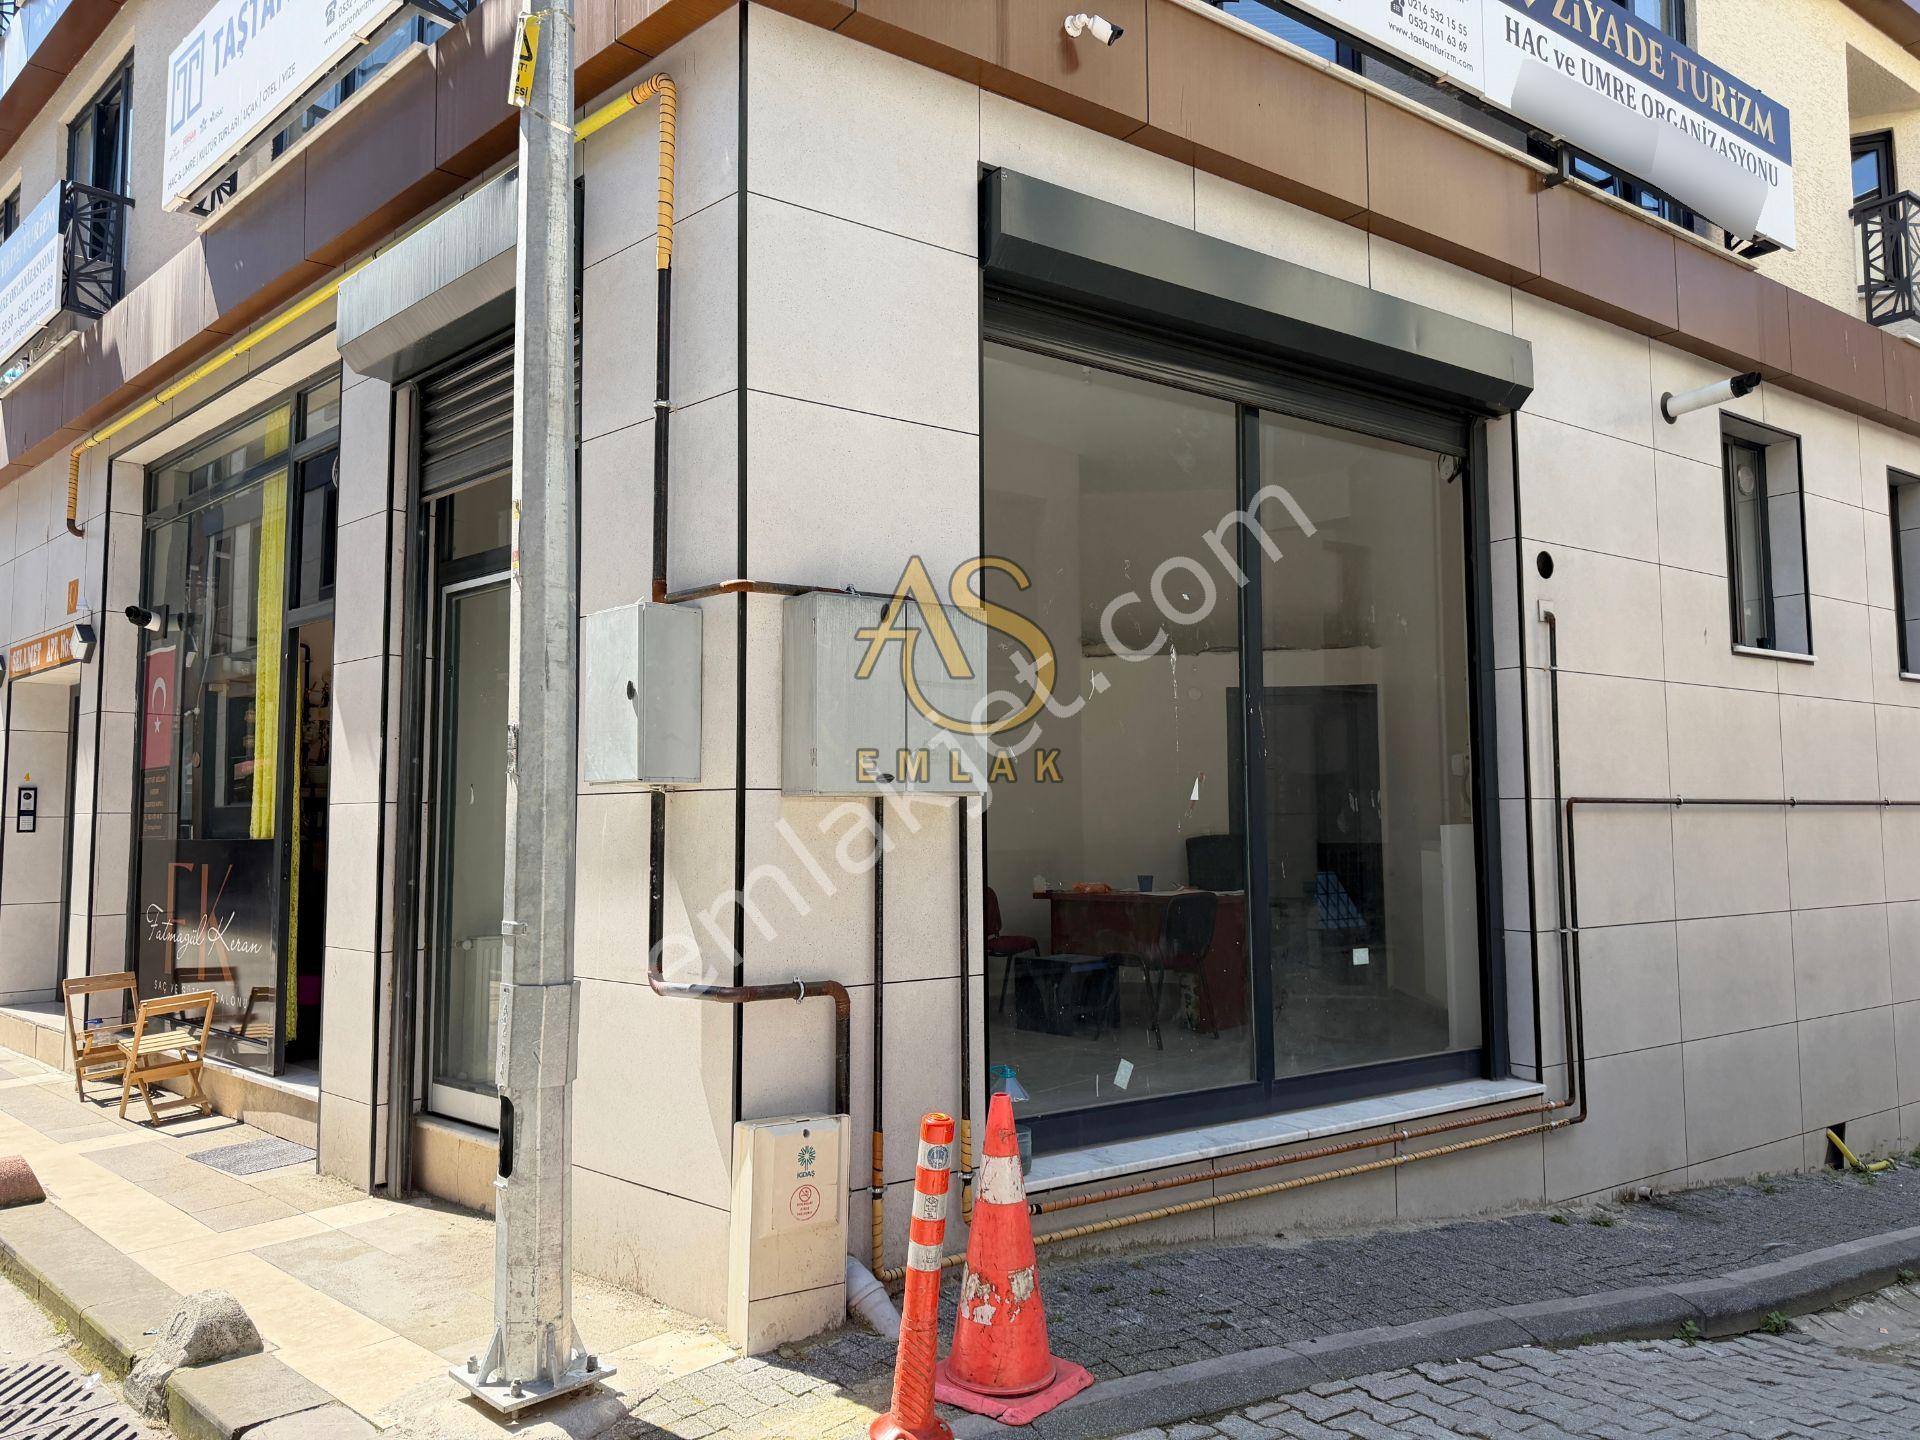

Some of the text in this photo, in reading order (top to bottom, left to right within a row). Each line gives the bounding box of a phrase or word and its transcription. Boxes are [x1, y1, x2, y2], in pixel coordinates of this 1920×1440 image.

[213, 0, 290, 77] TAŞTA
[1408, 0, 1468, 36] 0216 532 15 55
[1408, 13, 1468, 53] 0532 741 63 69
[1388, 21, 1474, 72] www.tastanturizm.com
[262, 82, 278, 103] OTEL
[1551, 0, 1776, 145] ZİYADE TURİZM
[1504, 15, 1779, 187] HAC ve UMRE ORGANİZASYONU
[207, 911, 263, 959] Keran
